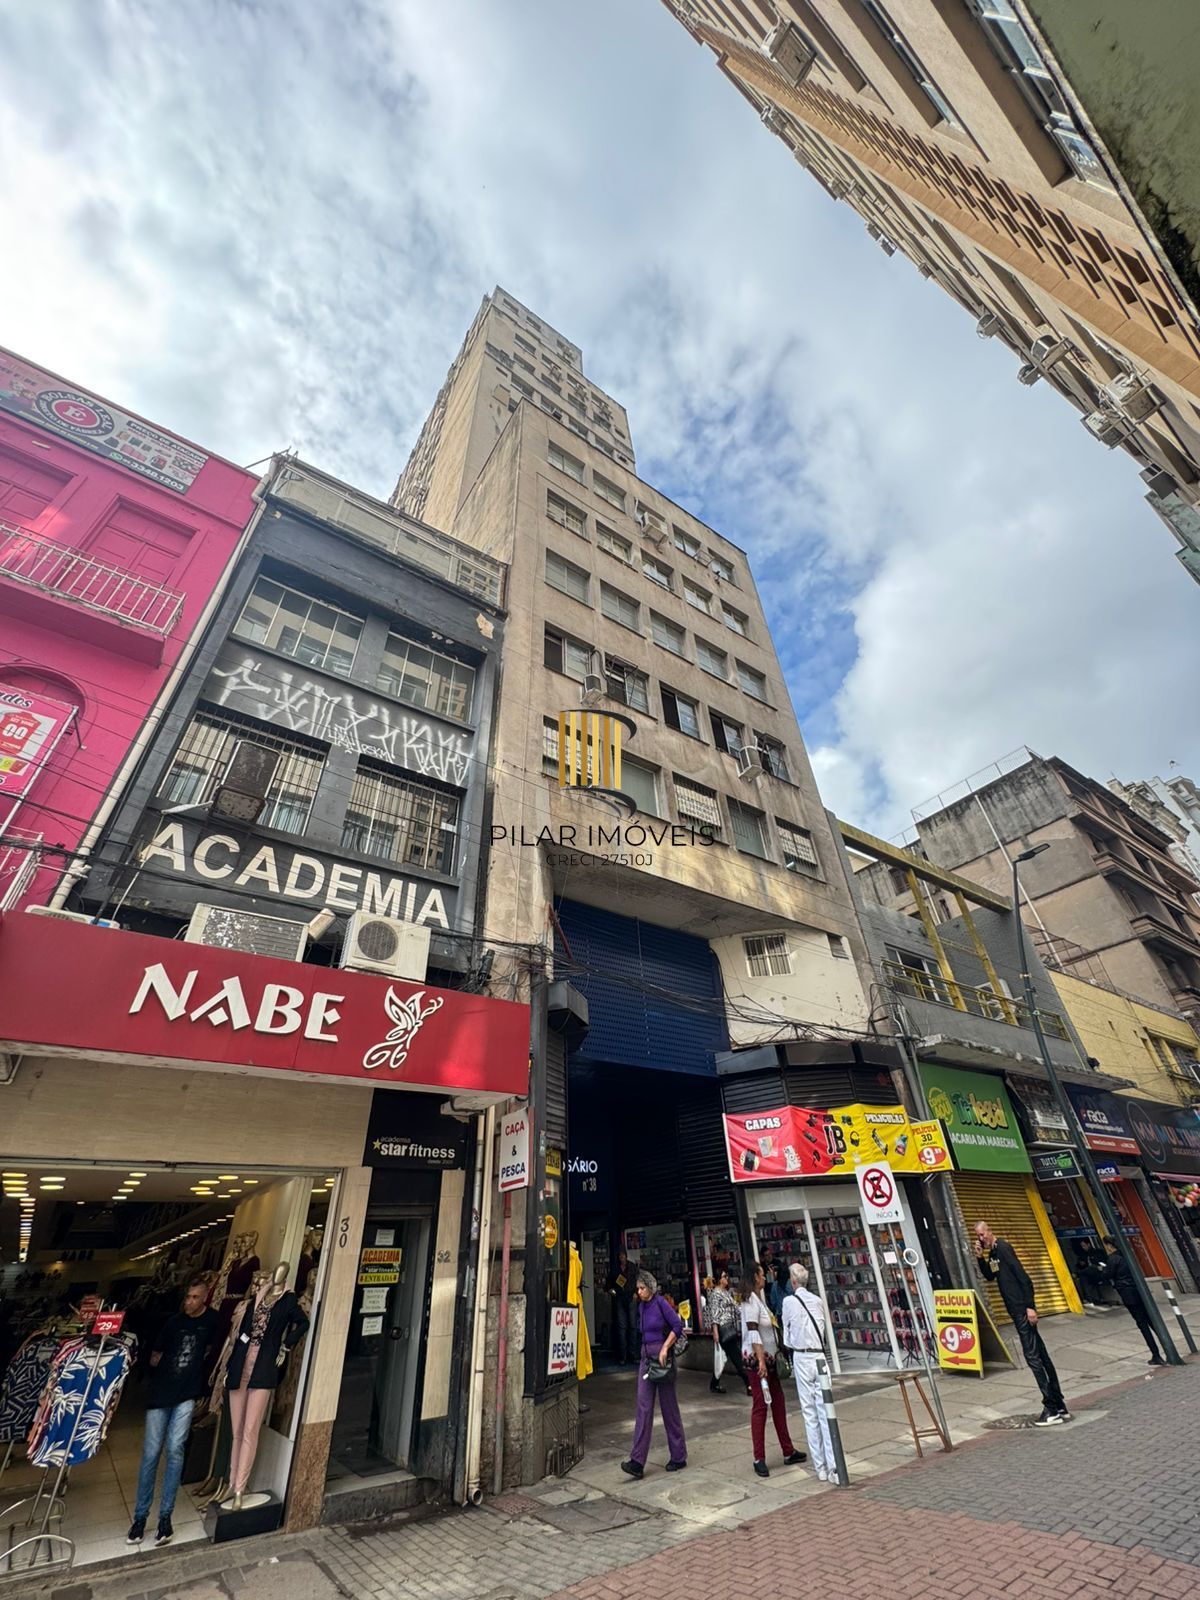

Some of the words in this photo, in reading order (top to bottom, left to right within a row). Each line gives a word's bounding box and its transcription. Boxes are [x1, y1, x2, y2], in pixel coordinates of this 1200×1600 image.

[138, 822, 450, 929] ACADEMIA
[128, 962, 345, 1043] NABE
[505, 1120, 525, 1136] CAÇA
[745, 1117, 781, 1131] CAPAS
[823, 1124, 847, 1154] JB
[921, 1133, 933, 1142] 3D
[950, 1132, 977, 1146] ACARIA
[511, 1145, 517, 1156] &
[501, 1162, 526, 1179] PESCA
[562, 1156, 598, 1173] SÁRIO
[362, 1249, 401, 1262] ACADEMIA
[437, 1250, 450, 1263] 32
[364, 1274, 393, 1282] ENTRADA
[935, 1294, 972, 1306] PELÍCULA
[555, 1310, 574, 1329] CAÇA
[561, 1326, 567, 1341] &
[552, 1342, 574, 1359] PESCA
